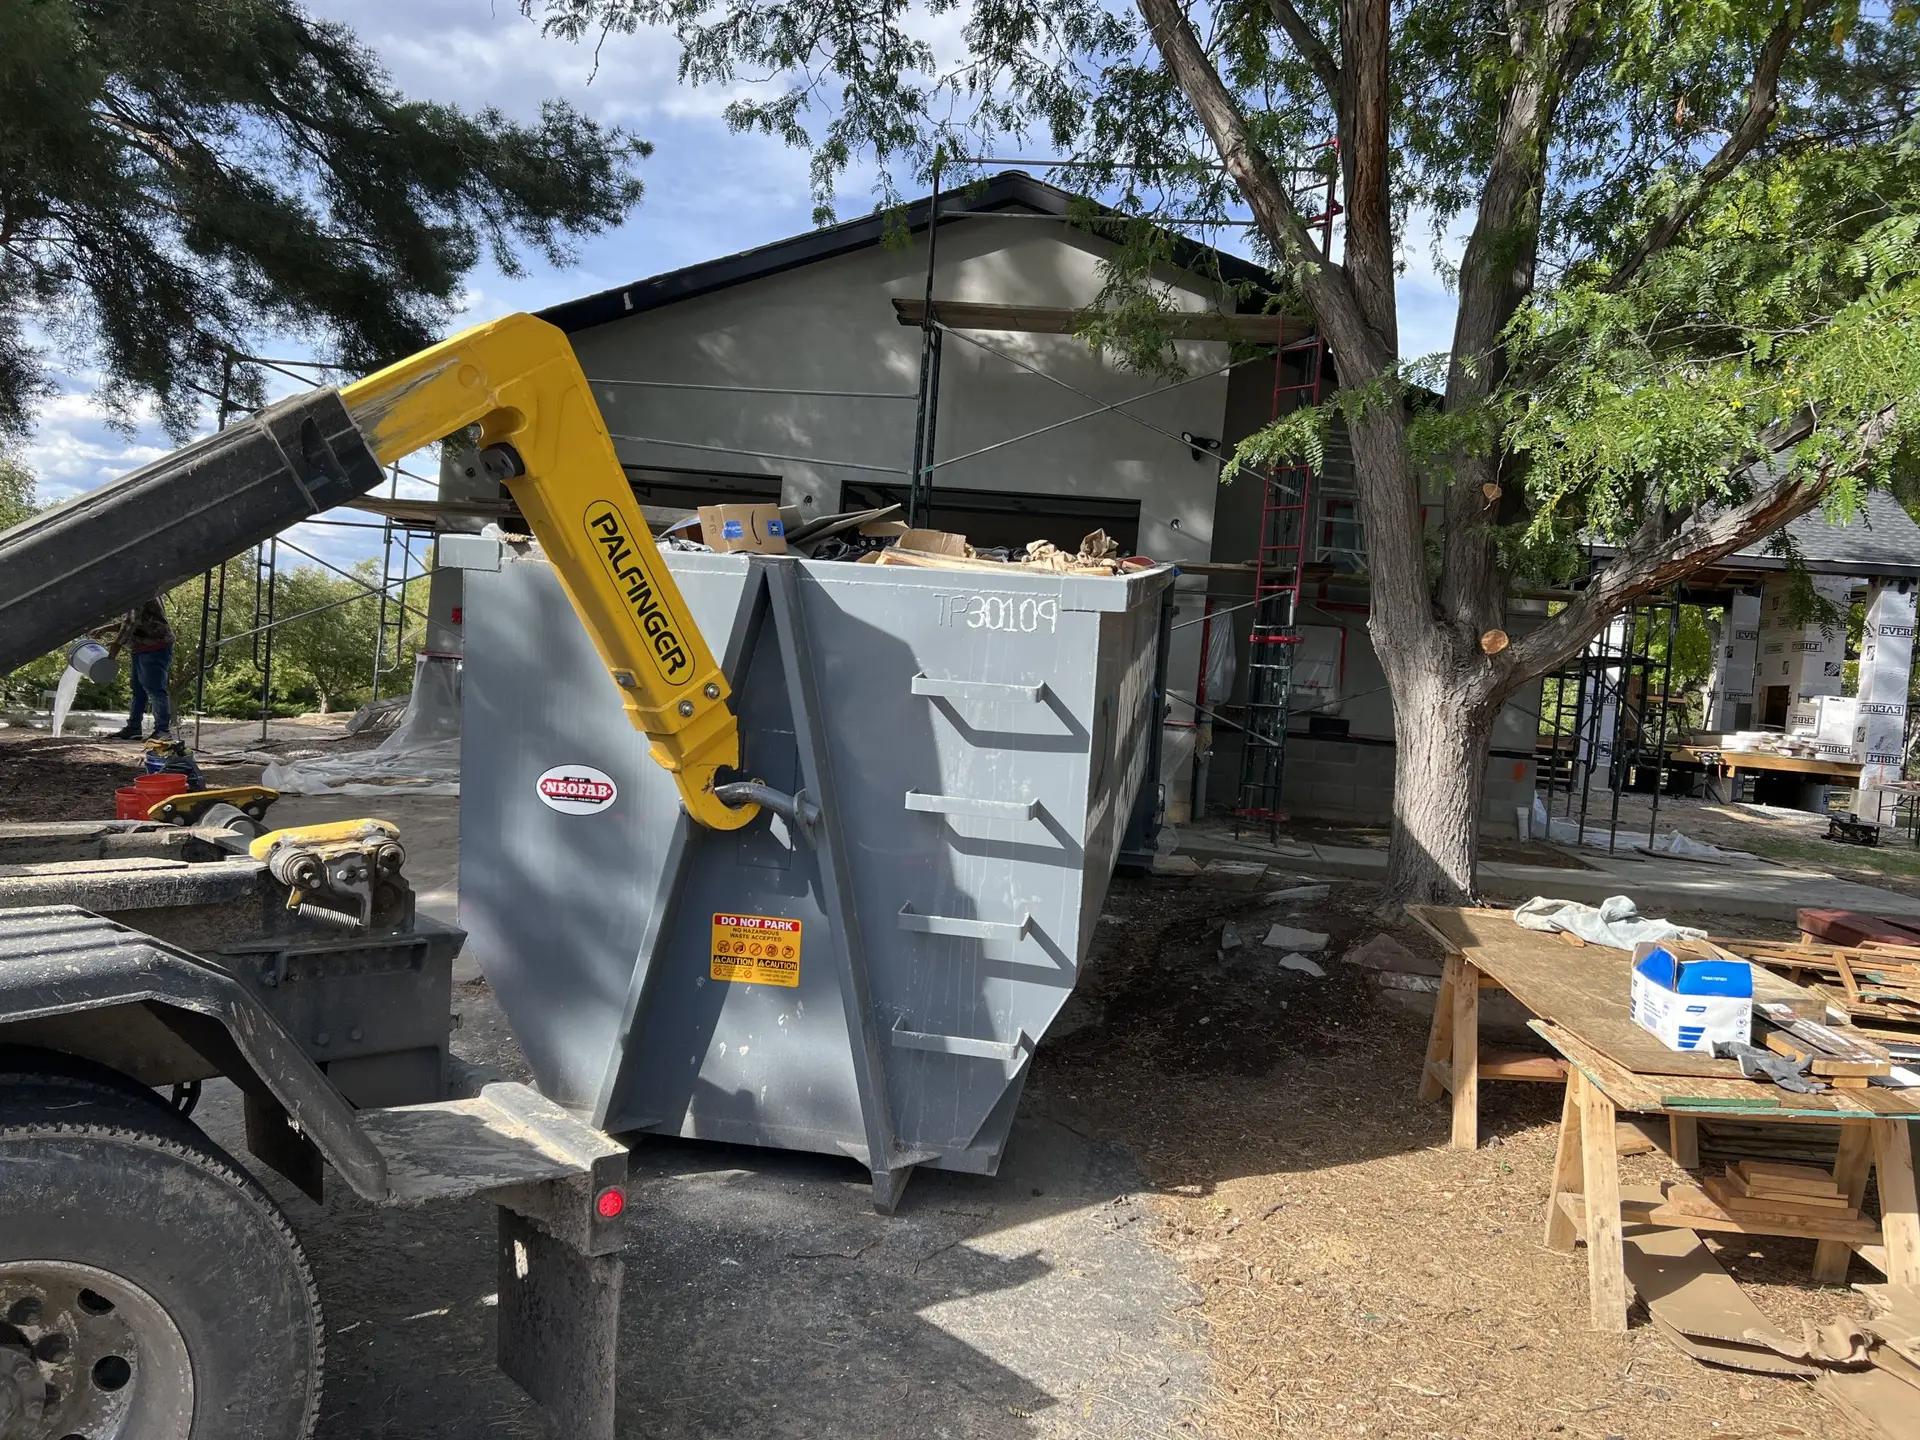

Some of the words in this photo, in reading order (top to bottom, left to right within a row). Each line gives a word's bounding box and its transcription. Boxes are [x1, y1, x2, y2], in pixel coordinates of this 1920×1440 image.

[591, 512, 686, 676] PALFINGER
[933, 594, 1057, 634] TP30109
[546, 781, 607, 797] NEOFAB
[721, 917, 737, 926] DO
[740, 918, 761, 928] NOT
[764, 920, 793, 930] PARK
[744, 928, 779, 936] HAZARDOUS
[720, 956, 753, 966] CAUTION
[765, 961, 797, 970] CAUTION
